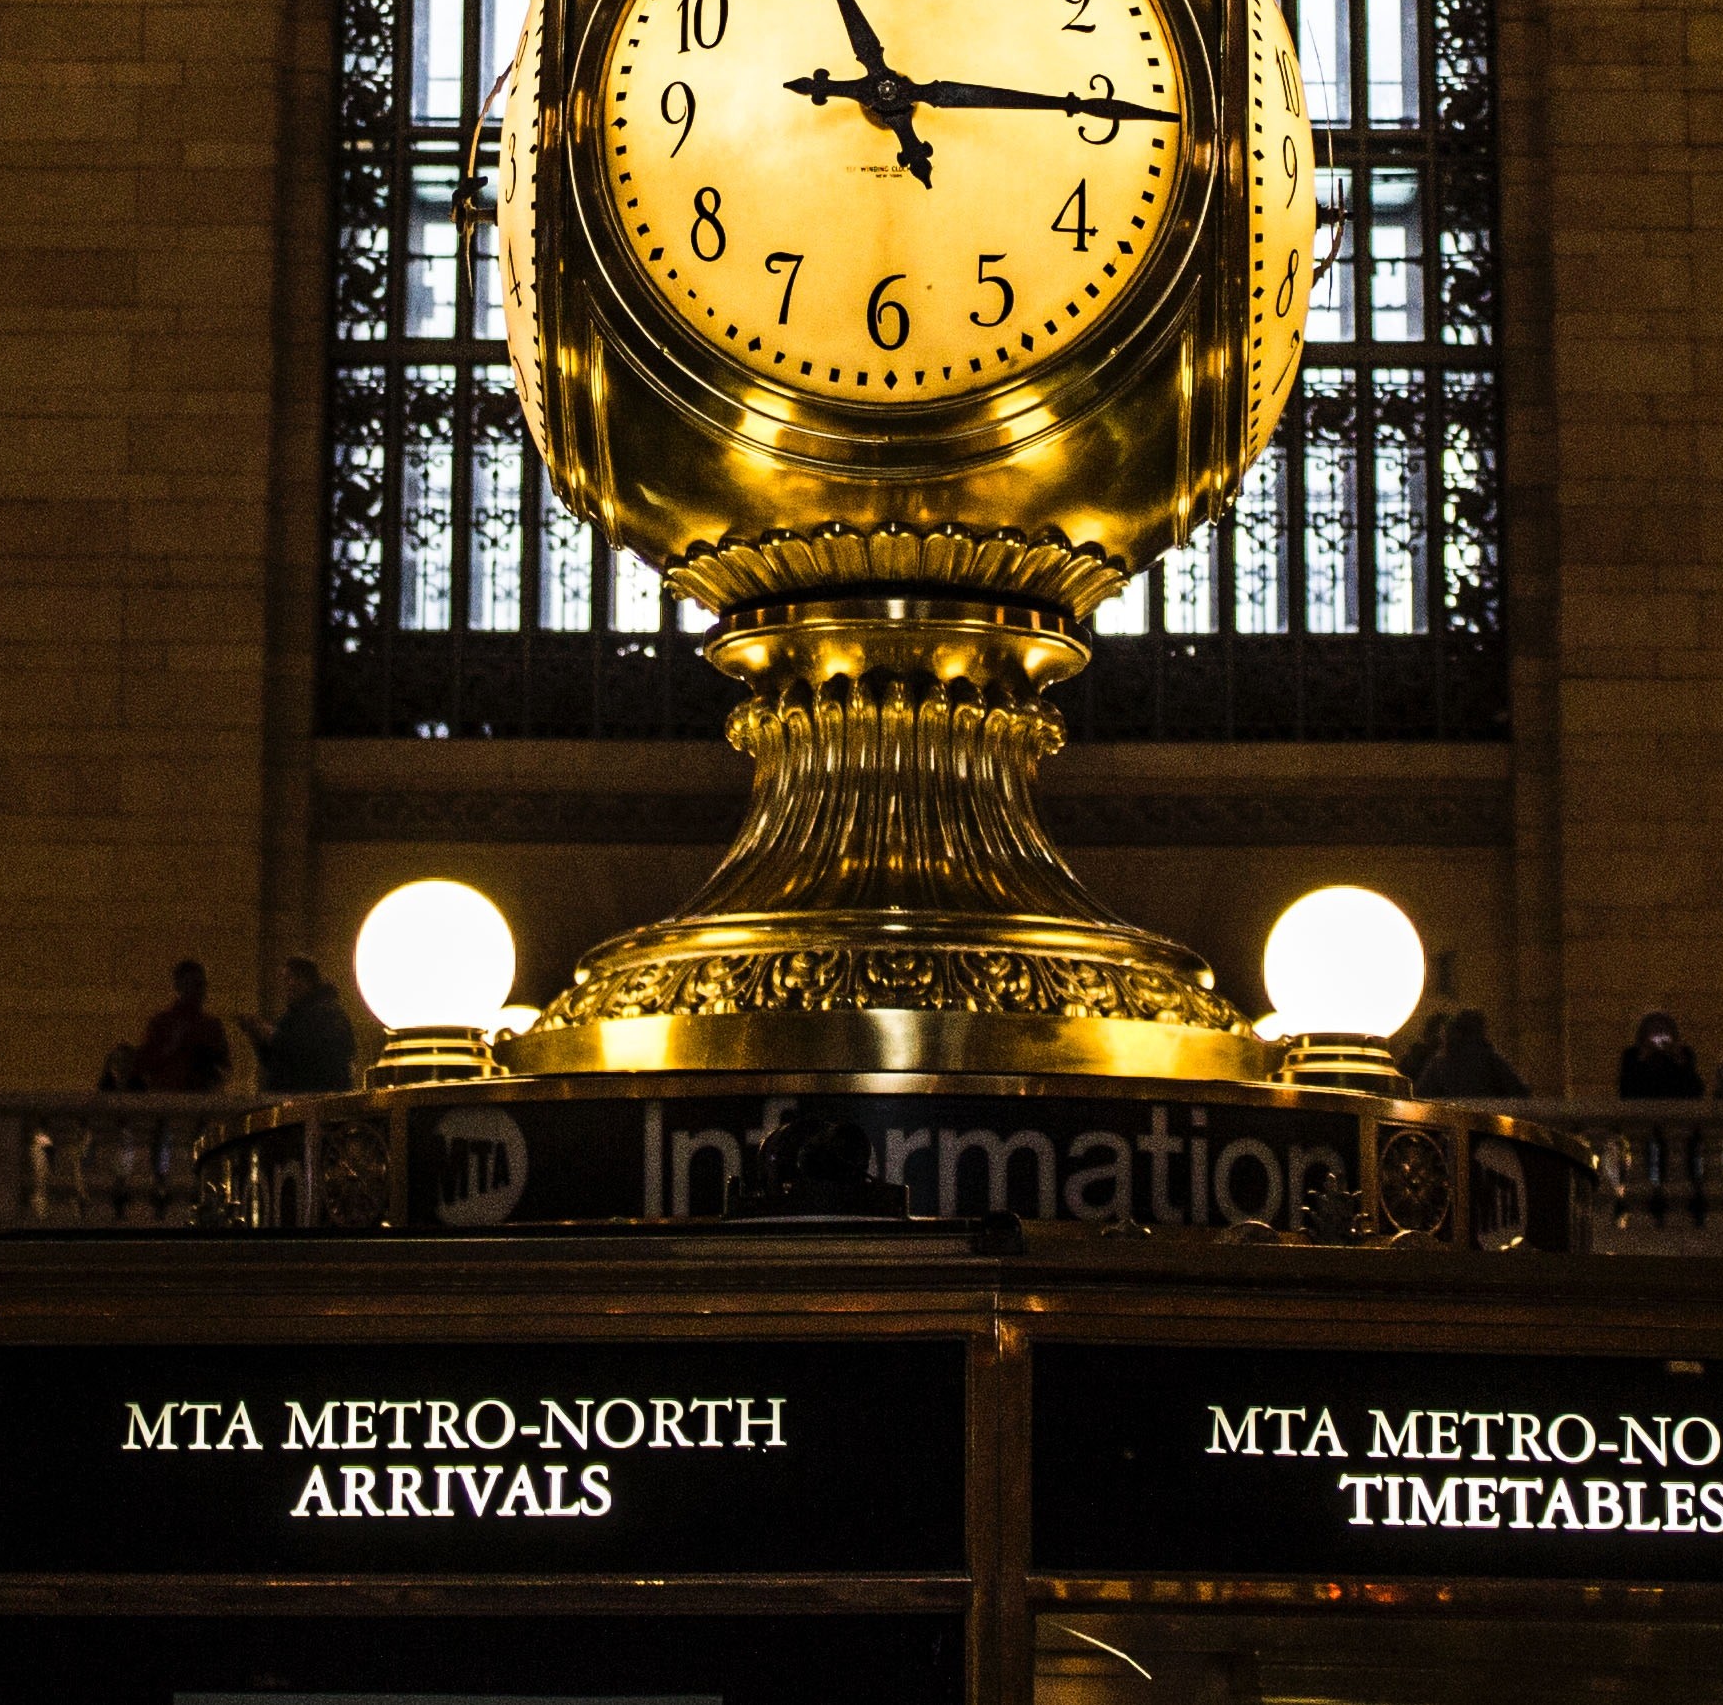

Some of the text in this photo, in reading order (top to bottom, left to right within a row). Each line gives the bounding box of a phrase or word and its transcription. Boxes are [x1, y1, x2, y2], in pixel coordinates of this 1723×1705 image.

[1077, 73, 1120, 145] 3
[1275, 46, 1300, 118] 10
[660, 81, 696, 159] 9
[505, 132, 517, 204] 3
[1282, 135, 1298, 209] 9
[690, 186, 727, 263] 8
[1050, 178, 1099, 253] 4
[507, 231, 523, 308] 4
[764, 251, 805, 325] 7
[969, 253, 1015, 328] 5
[1275, 248, 1299, 318] 8
[866, 273, 911, 352] 6
[1271, 331, 1300, 395] 7
[644, 1098, 1346, 1227] Infrmation
[121, 1397, 788, 1451] MTA METRO-NORTH
[1204, 1405, 1349, 1458] MTA
[289, 1463, 612, 1518] ARRIVALS
